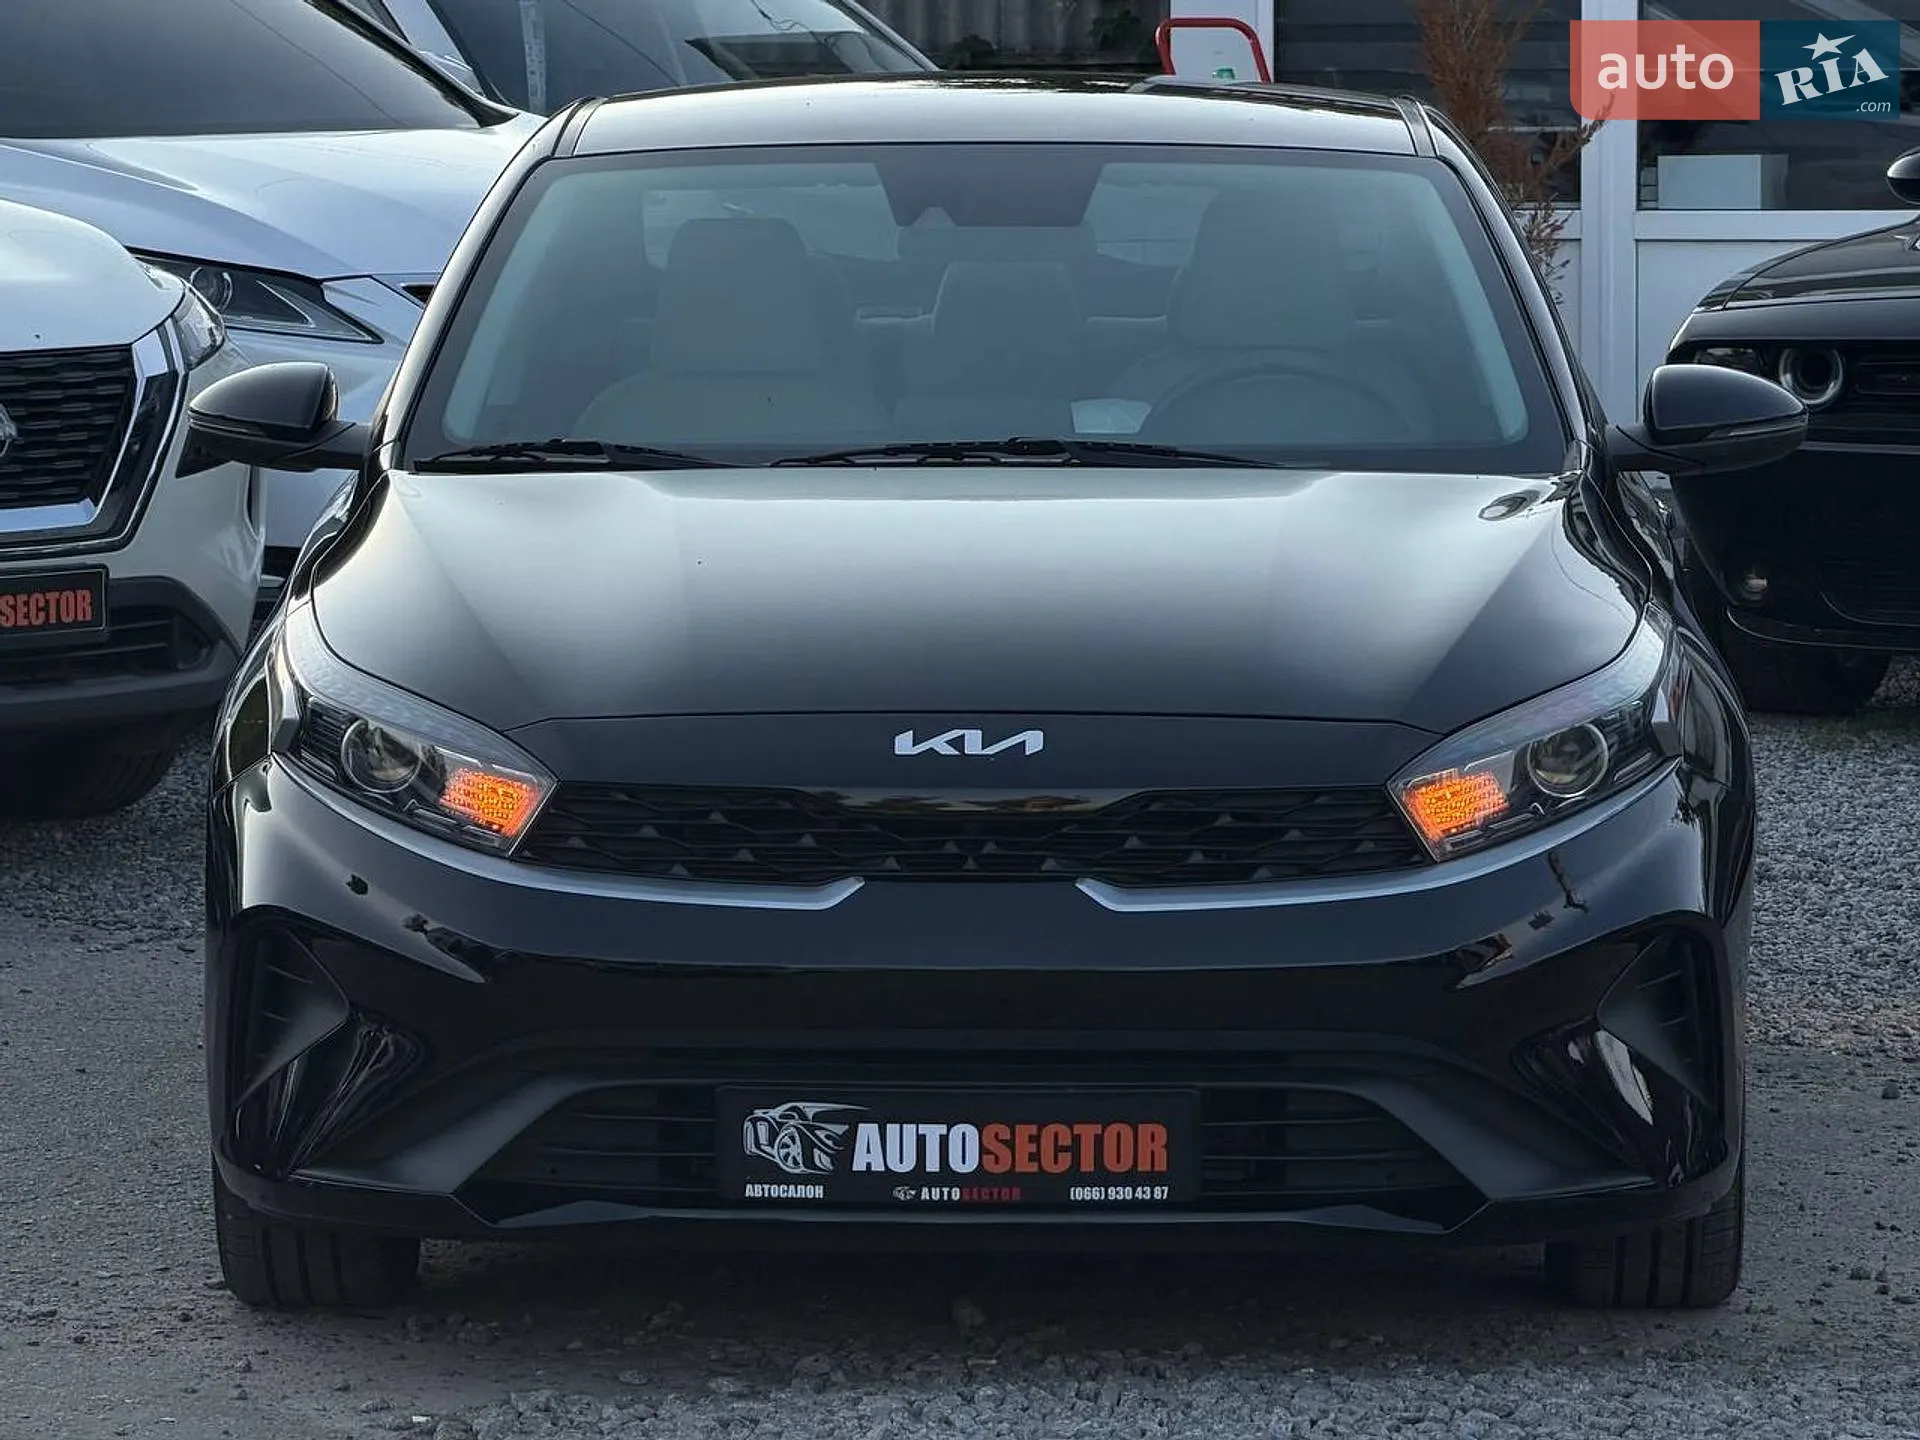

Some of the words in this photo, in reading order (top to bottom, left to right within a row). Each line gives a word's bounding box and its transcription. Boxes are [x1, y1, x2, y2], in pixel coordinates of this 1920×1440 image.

[0, 589, 93, 628] SECTOR
[745, 1183, 824, 1199] АВТОСАЛОН
[1070, 1186, 1105, 1200] (066)
[1108, 1186, 1133, 1200] 930
[1135, 1186, 1151, 1200] 43
